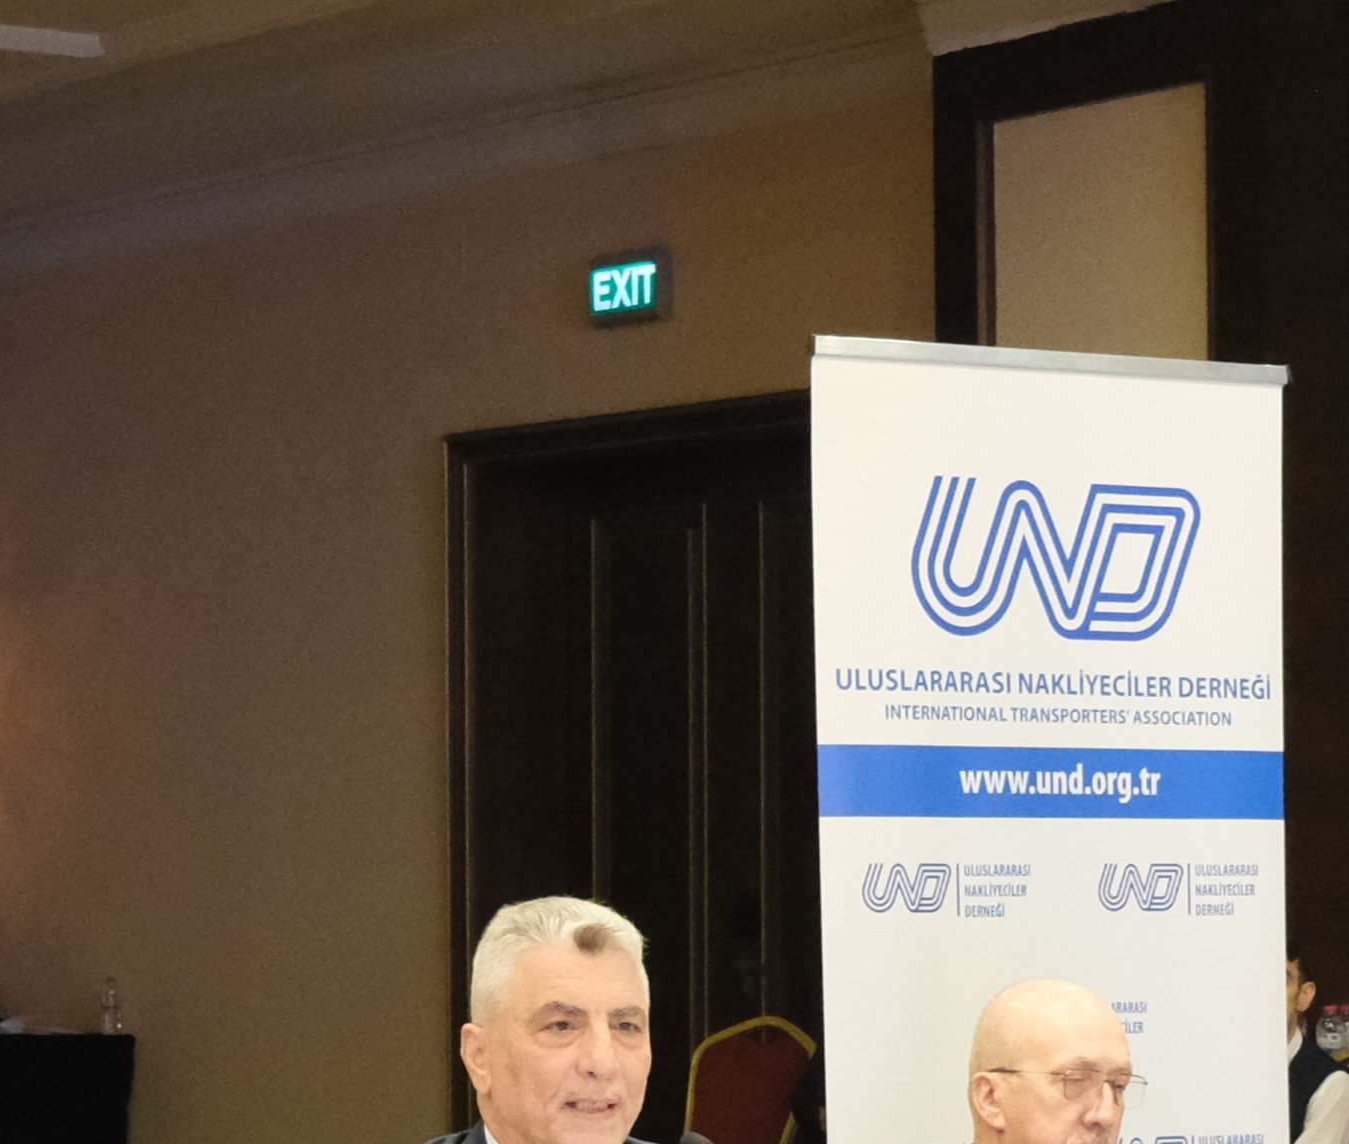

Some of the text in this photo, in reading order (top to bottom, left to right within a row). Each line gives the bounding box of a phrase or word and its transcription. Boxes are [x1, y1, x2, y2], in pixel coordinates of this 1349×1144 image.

[593, 264, 656, 311] EXIT
[911, 475, 1201, 641] UND
[835, 668, 1271, 700] ULUSLARARASI NAKLİYECİLER DERNEĞİ
[884, 704, 1007, 722] INTERNATIONAL
[1132, 710, 1232, 726] ASSOCIATION
[959, 763, 1161, 803] www.und.org.tr
[963, 863, 1031, 876] ULUSLARARASI
[1195, 863, 1259, 876] ULUSLARARASI
[861, 862, 952, 913] UND
[1098, 863, 1183, 912] UND
[965, 902, 1005, 917] DERNEĞİ
[1195, 901, 1234, 916] DERNEĞİ
